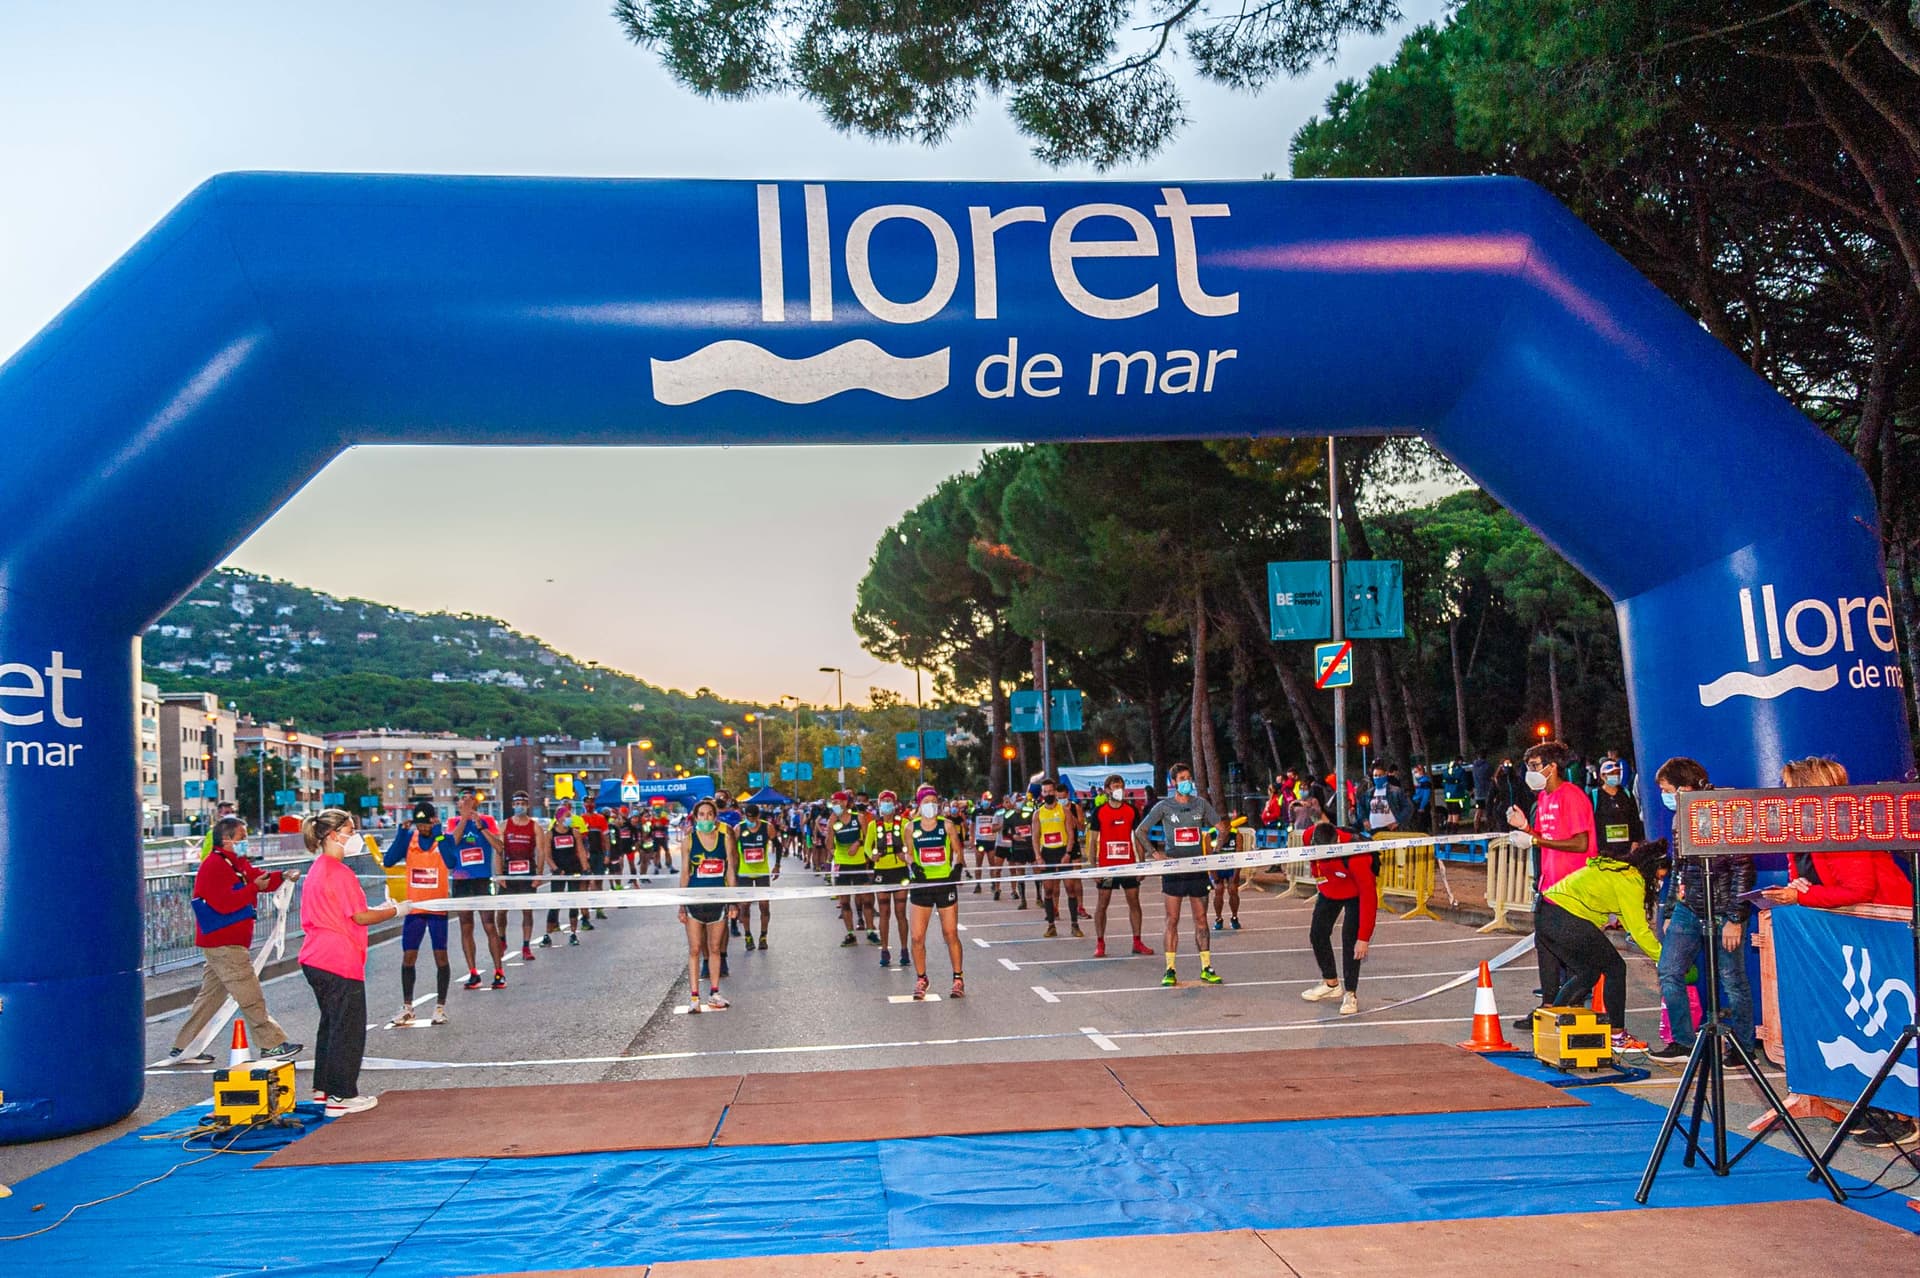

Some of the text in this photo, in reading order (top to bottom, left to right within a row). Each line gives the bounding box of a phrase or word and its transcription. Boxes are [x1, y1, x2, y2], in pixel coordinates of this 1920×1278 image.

[757, 184, 1239, 323] lloret
[975, 337, 1237, 398] de mar
[1276, 592, 1293, 606] BE
[1848, 659, 1880, 688] de
[6, 741, 83, 767] mar
